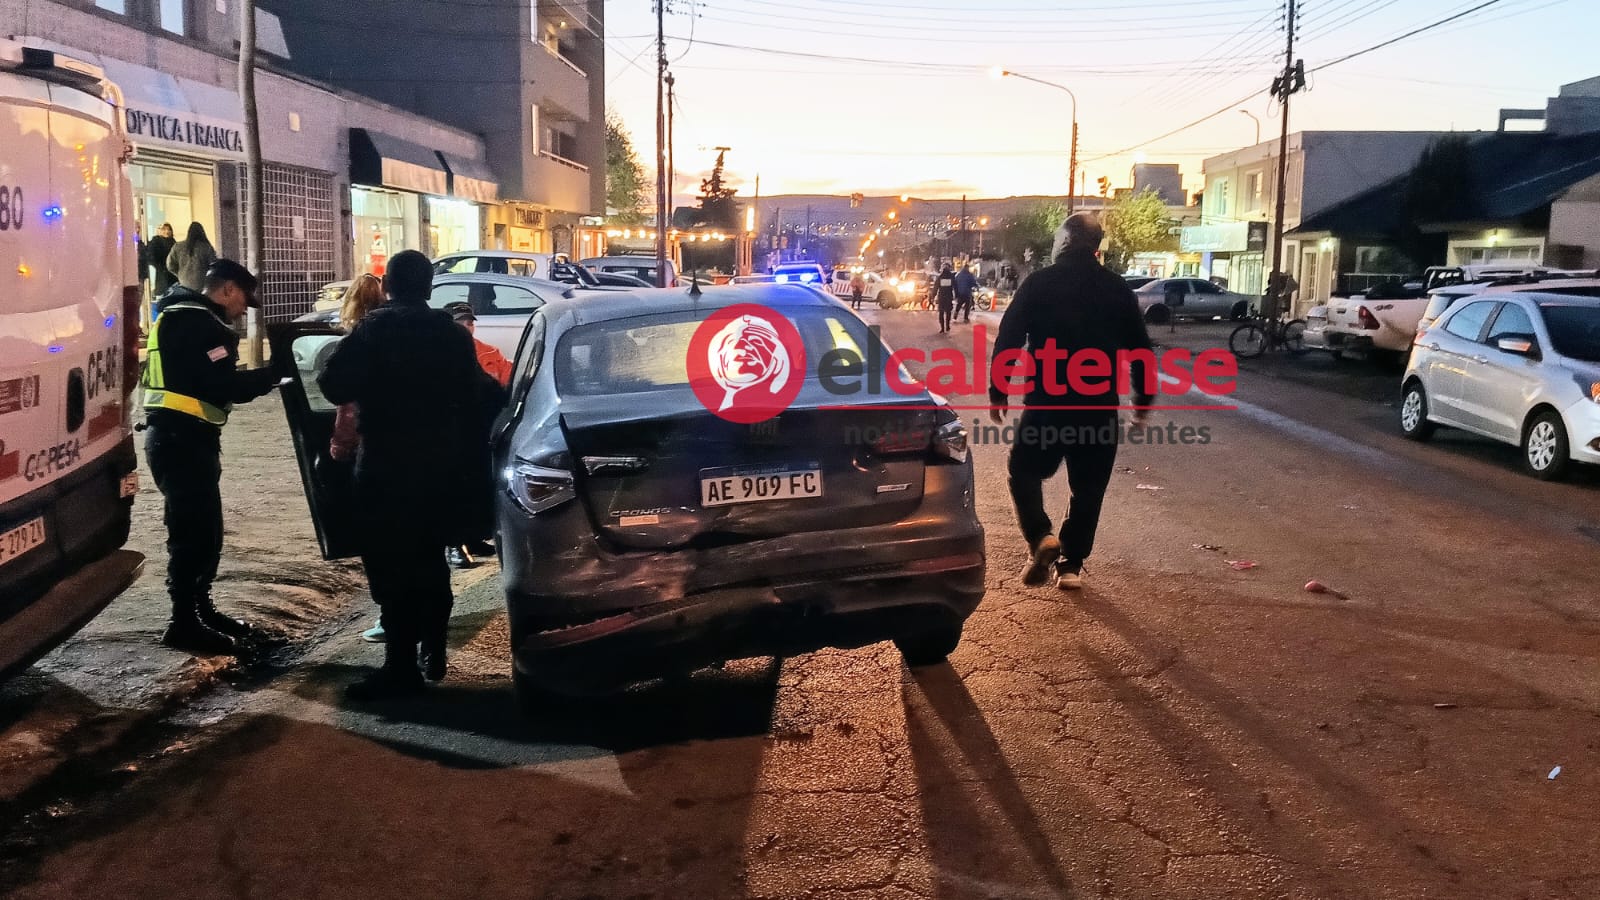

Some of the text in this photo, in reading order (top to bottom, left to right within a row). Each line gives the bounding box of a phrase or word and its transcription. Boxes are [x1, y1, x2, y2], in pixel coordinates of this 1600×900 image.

[708, 472, 816, 502] AE 909 FC
